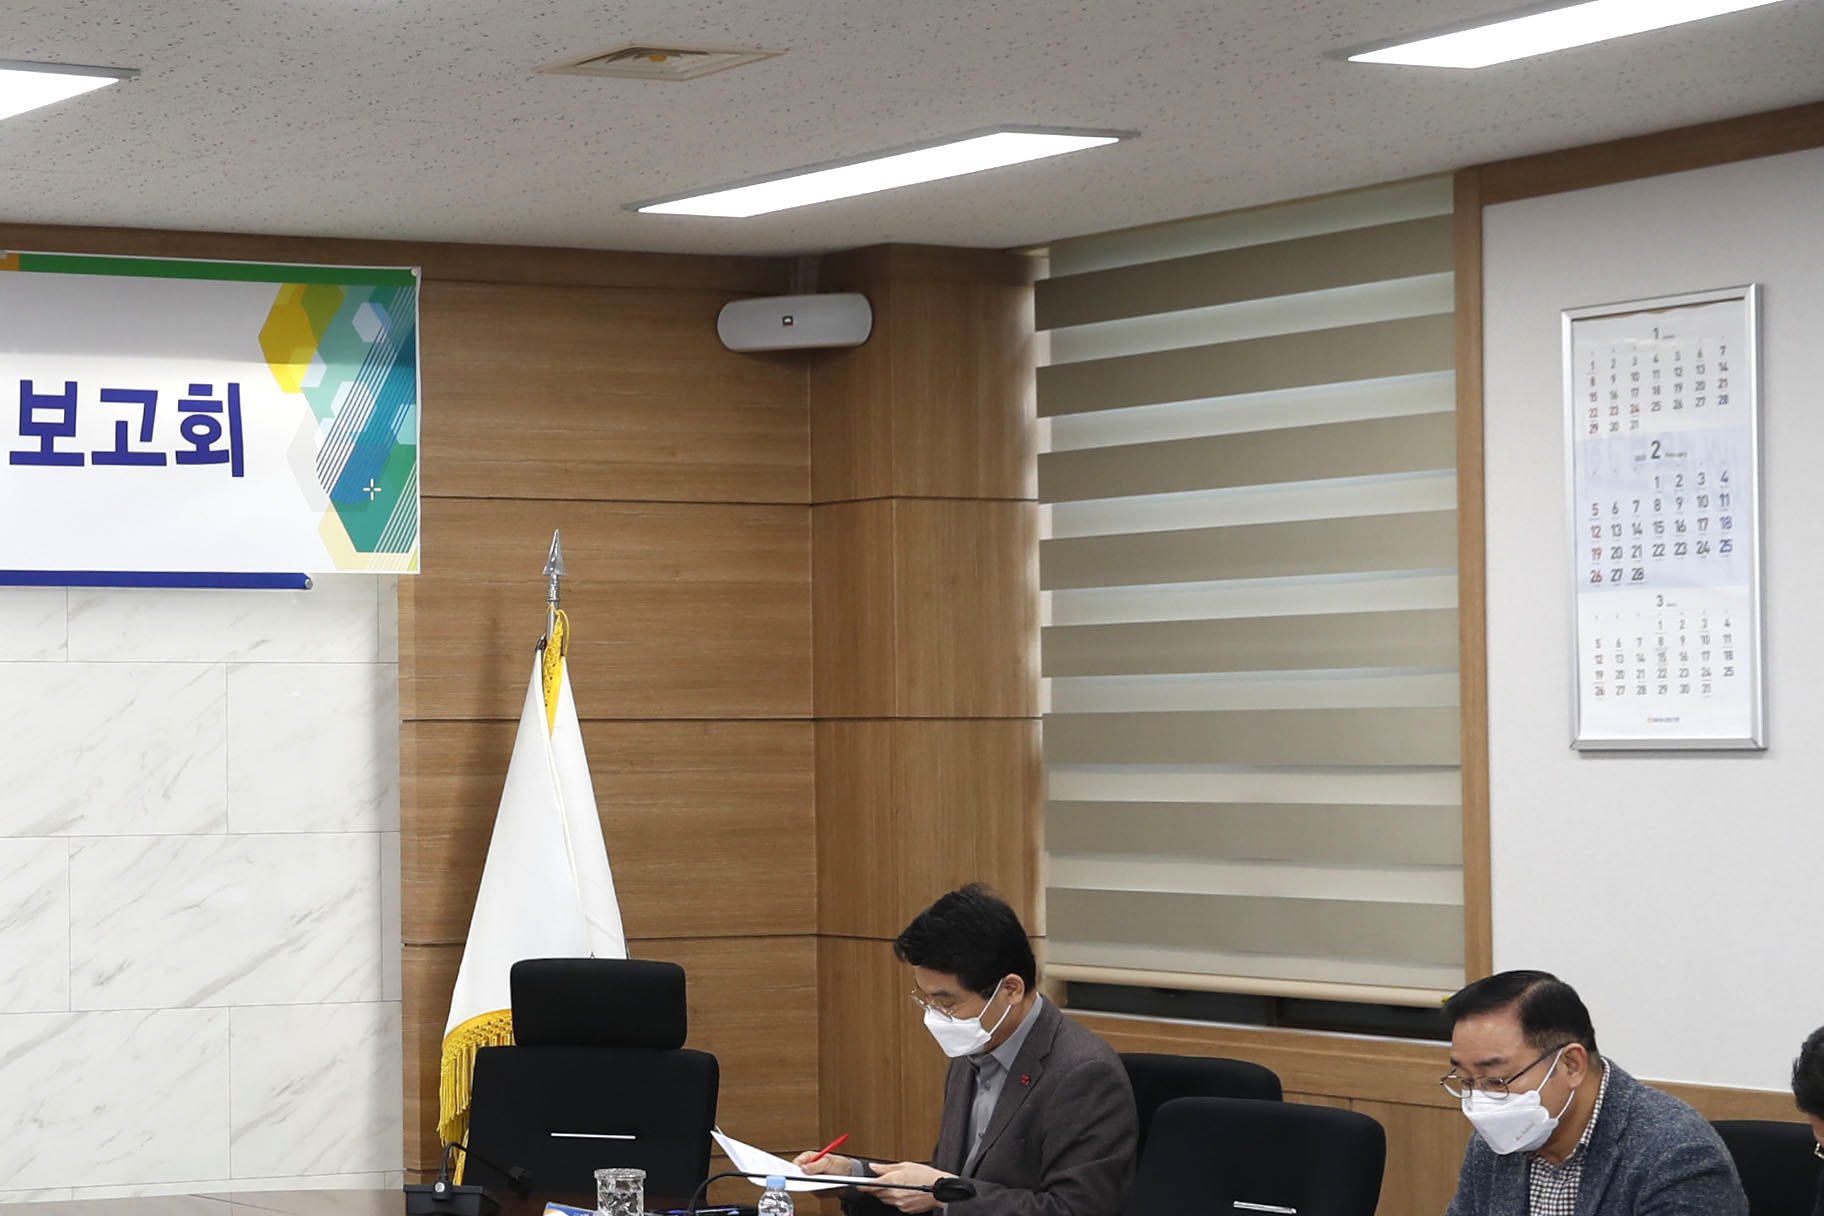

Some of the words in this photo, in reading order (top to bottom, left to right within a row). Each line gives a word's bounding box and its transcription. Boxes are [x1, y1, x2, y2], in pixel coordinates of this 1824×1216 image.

[8, 380, 246, 478] 보고회
[1650, 439, 1662, 460] 2
[1653, 475, 1660, 490] 1
[1674, 473, 1684, 489] 2
[1719, 469, 1730, 484] 4
[1632, 499, 1641, 514] 7
[1675, 496, 1684, 510] 9
[1718, 492, 1730, 508] 11
[1589, 524, 1602, 539] 12
[1652, 542, 1666, 558] 22
[1719, 538, 1733, 554] 25
